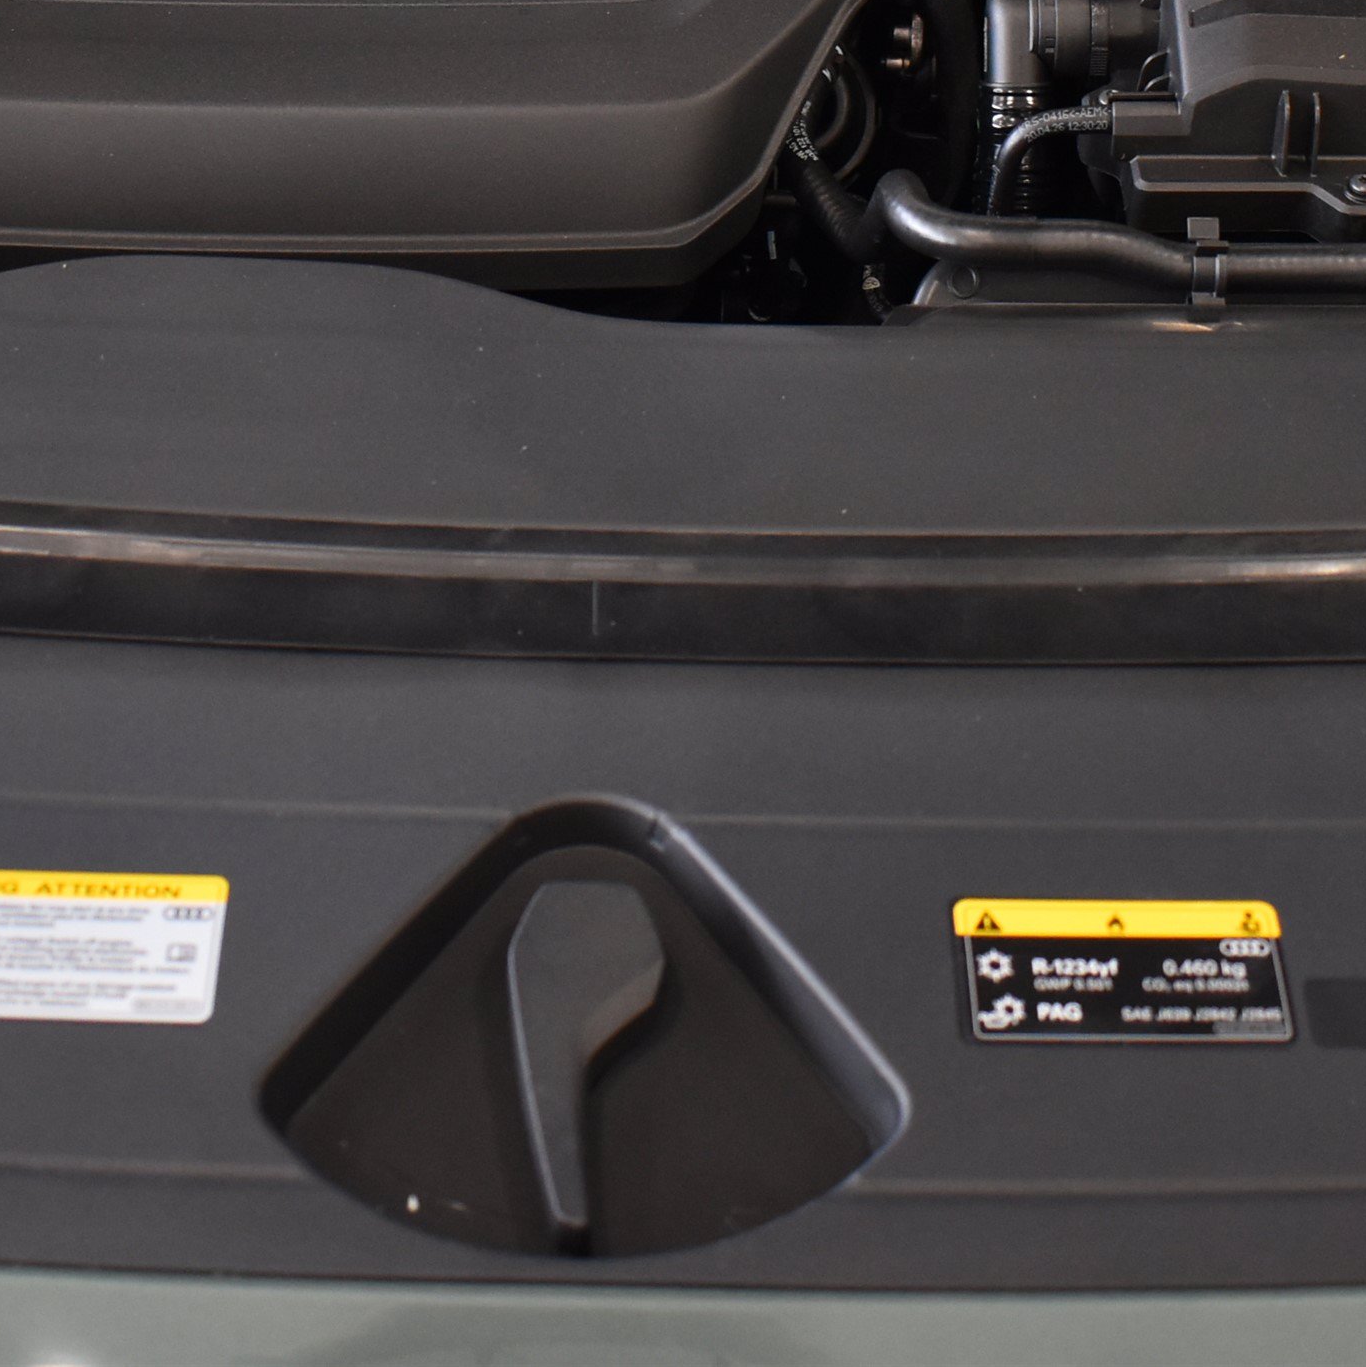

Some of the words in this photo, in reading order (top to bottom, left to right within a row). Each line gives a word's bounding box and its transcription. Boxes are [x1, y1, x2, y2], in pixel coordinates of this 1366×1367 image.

[36, 882, 183, 900] ATTENTION
[1031, 956, 1120, 979] R-1234yf
[1221, 958, 1247, 980] kg
[1036, 1001, 1084, 1023] PAG
